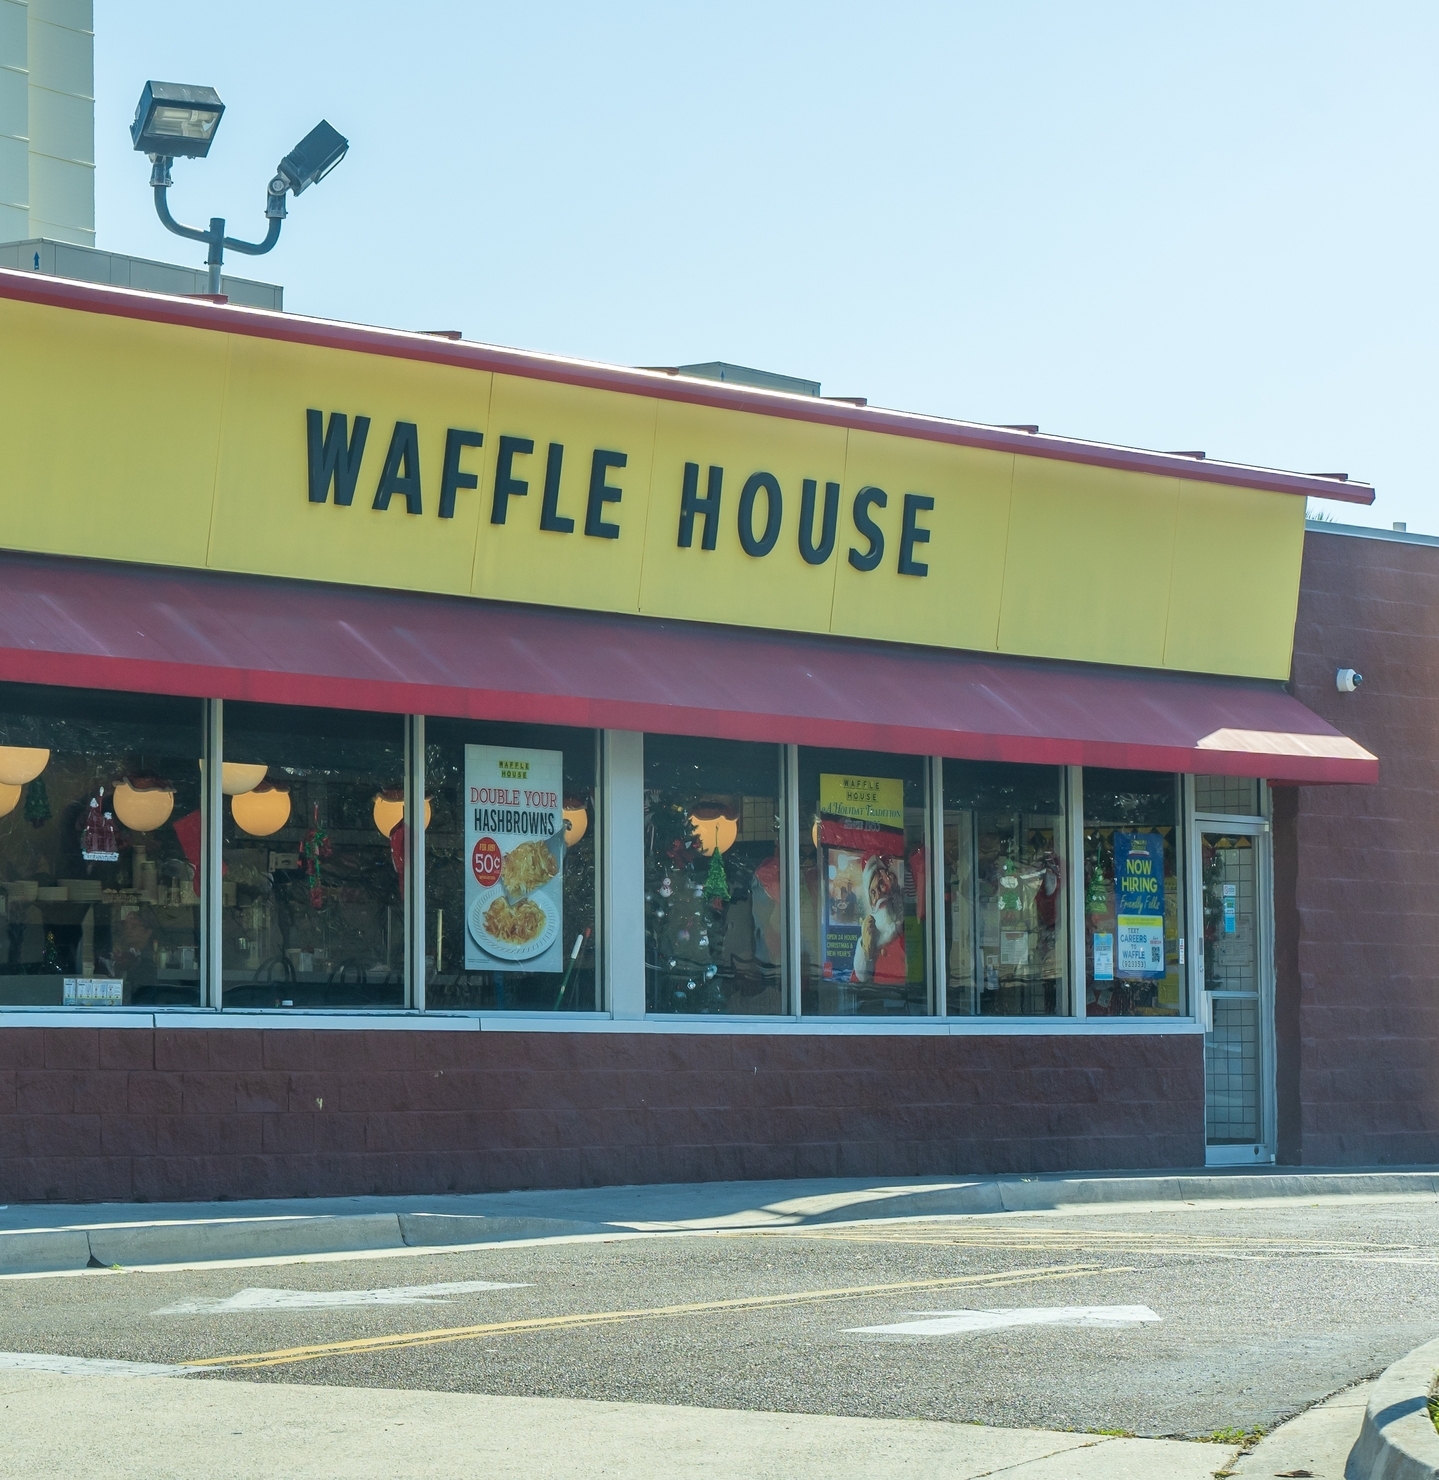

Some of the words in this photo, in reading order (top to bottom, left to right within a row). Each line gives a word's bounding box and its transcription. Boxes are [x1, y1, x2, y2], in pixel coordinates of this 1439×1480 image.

[306, 408, 628, 539] WAFFLE
[677, 462, 935, 577] HOUSE
[498, 760, 530, 770] WAFFLE
[501, 770, 527, 779] HOUSE
[844, 779, 880, 790] WAFFLE
[470, 787, 520, 806] DOUBLE
[524, 790, 558, 808] YOUR
[847, 792, 877, 801] HOUSE
[474, 808, 555, 836] HASHBROWNS
[1126, 859, 1152, 875] NOW
[1121, 877, 1158, 893] HIRING
[1120, 934, 1148, 943] CAREERS
[1122, 950, 1146, 960] WAFFLE
